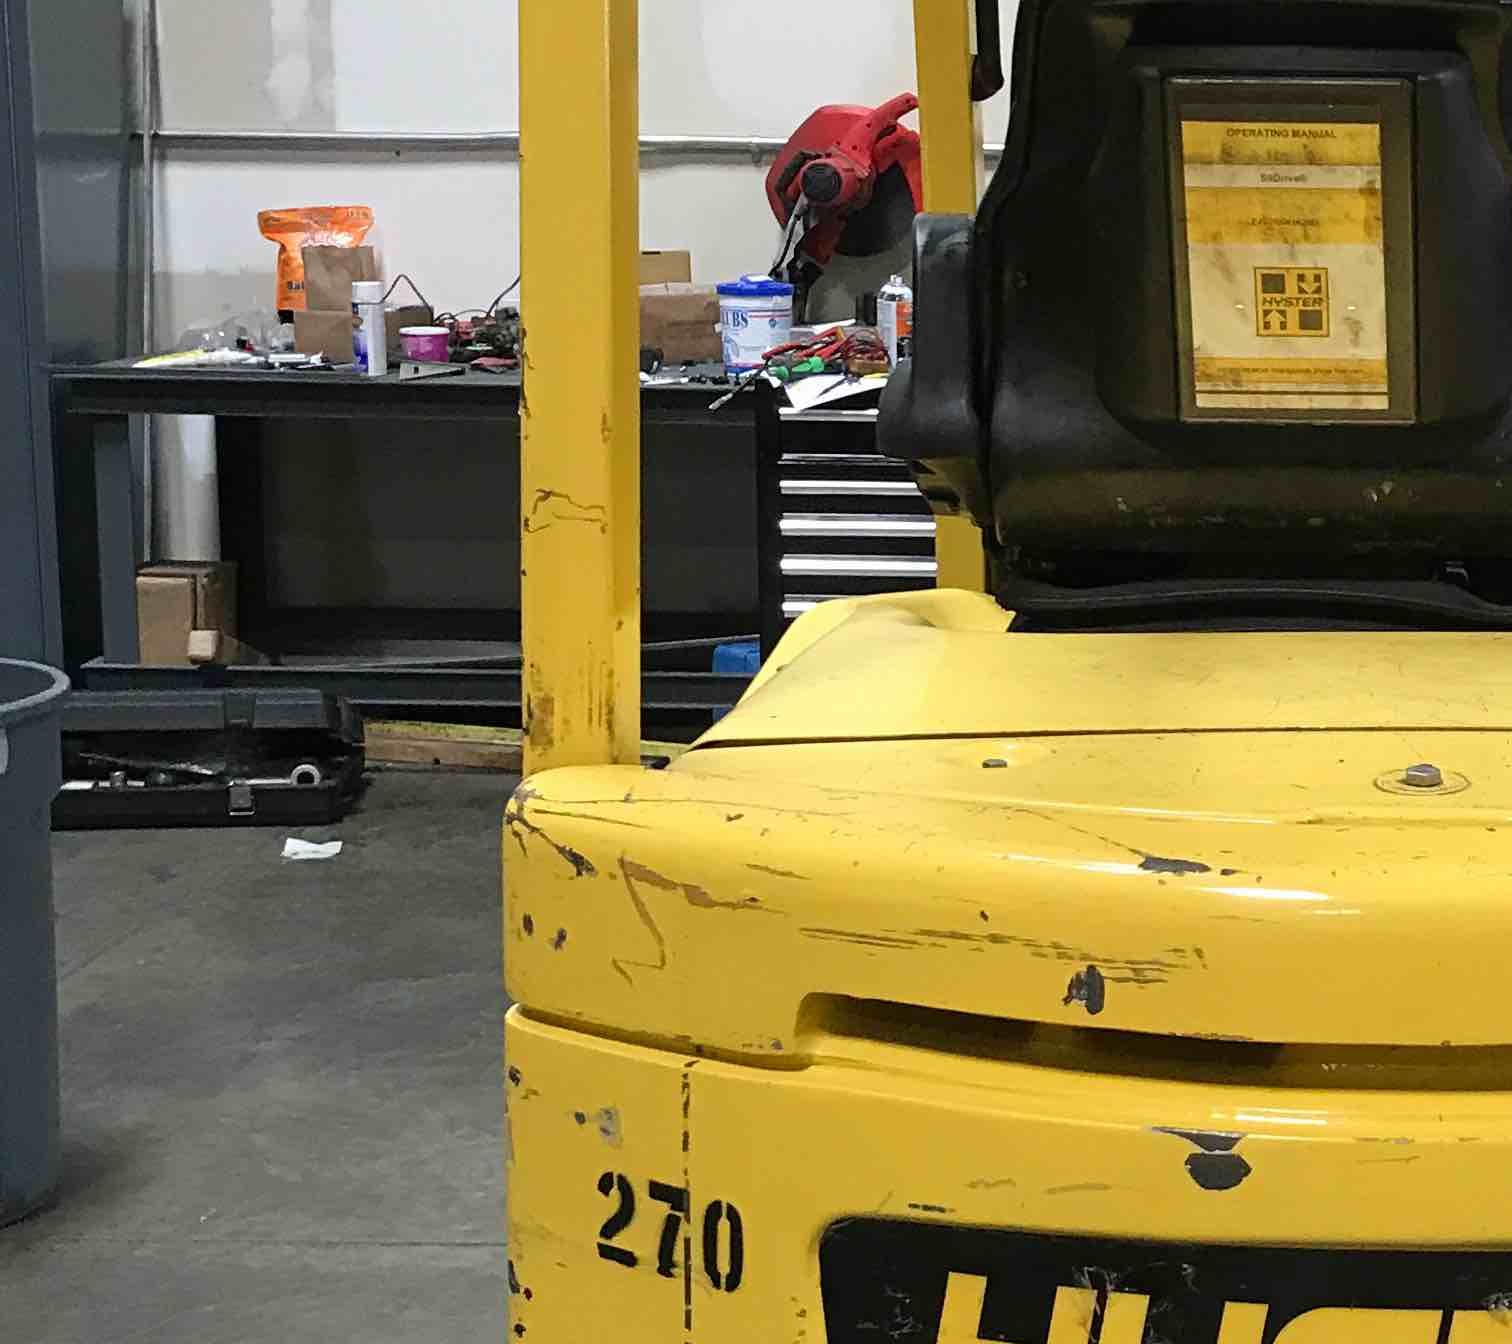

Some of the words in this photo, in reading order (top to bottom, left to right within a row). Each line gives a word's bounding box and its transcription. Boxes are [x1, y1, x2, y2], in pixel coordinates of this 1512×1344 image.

[1226, 128, 1289, 138] OPERATING
[1292, 129, 1337, 138] MANUAL
[1262, 296, 1323, 307] HYSTER
[596, 1171, 744, 1293] 270
